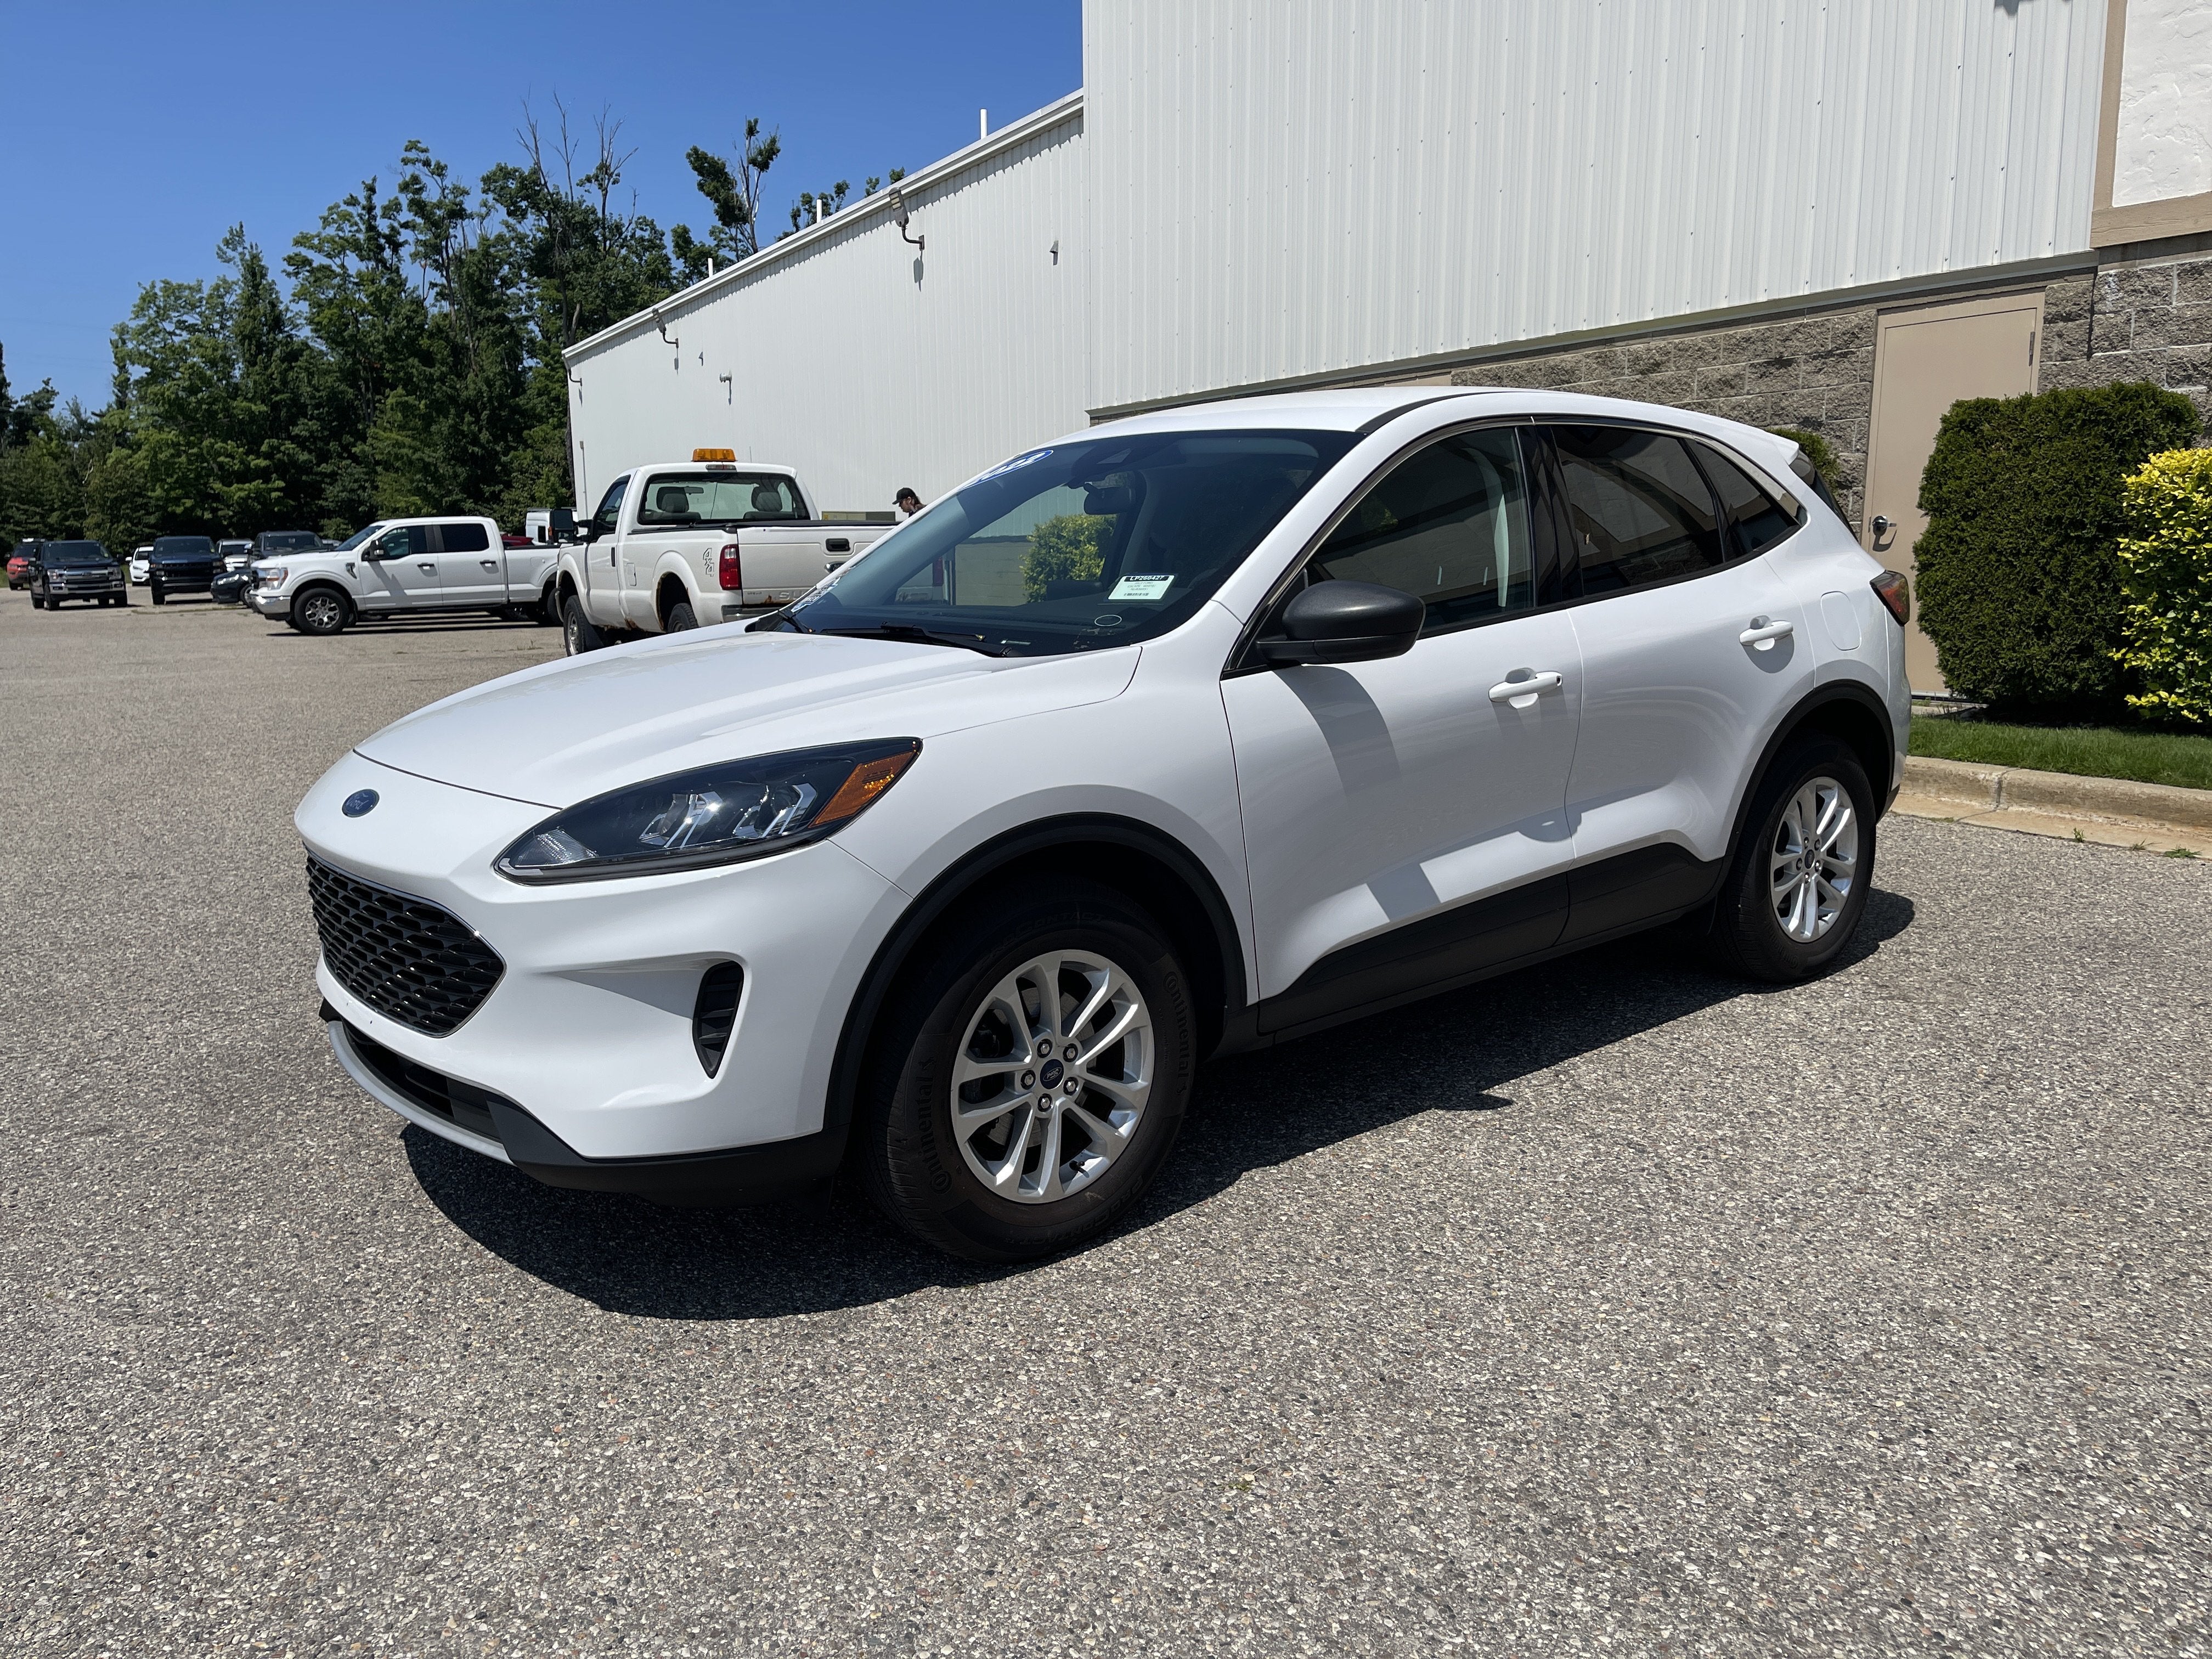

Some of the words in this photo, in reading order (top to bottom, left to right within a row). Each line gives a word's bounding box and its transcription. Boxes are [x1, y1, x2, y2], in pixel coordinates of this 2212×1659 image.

[703, 548, 714, 577] 4x4
[1163, 972, 1189, 1077] Continental
[915, 1075, 953, 1195] Continental
